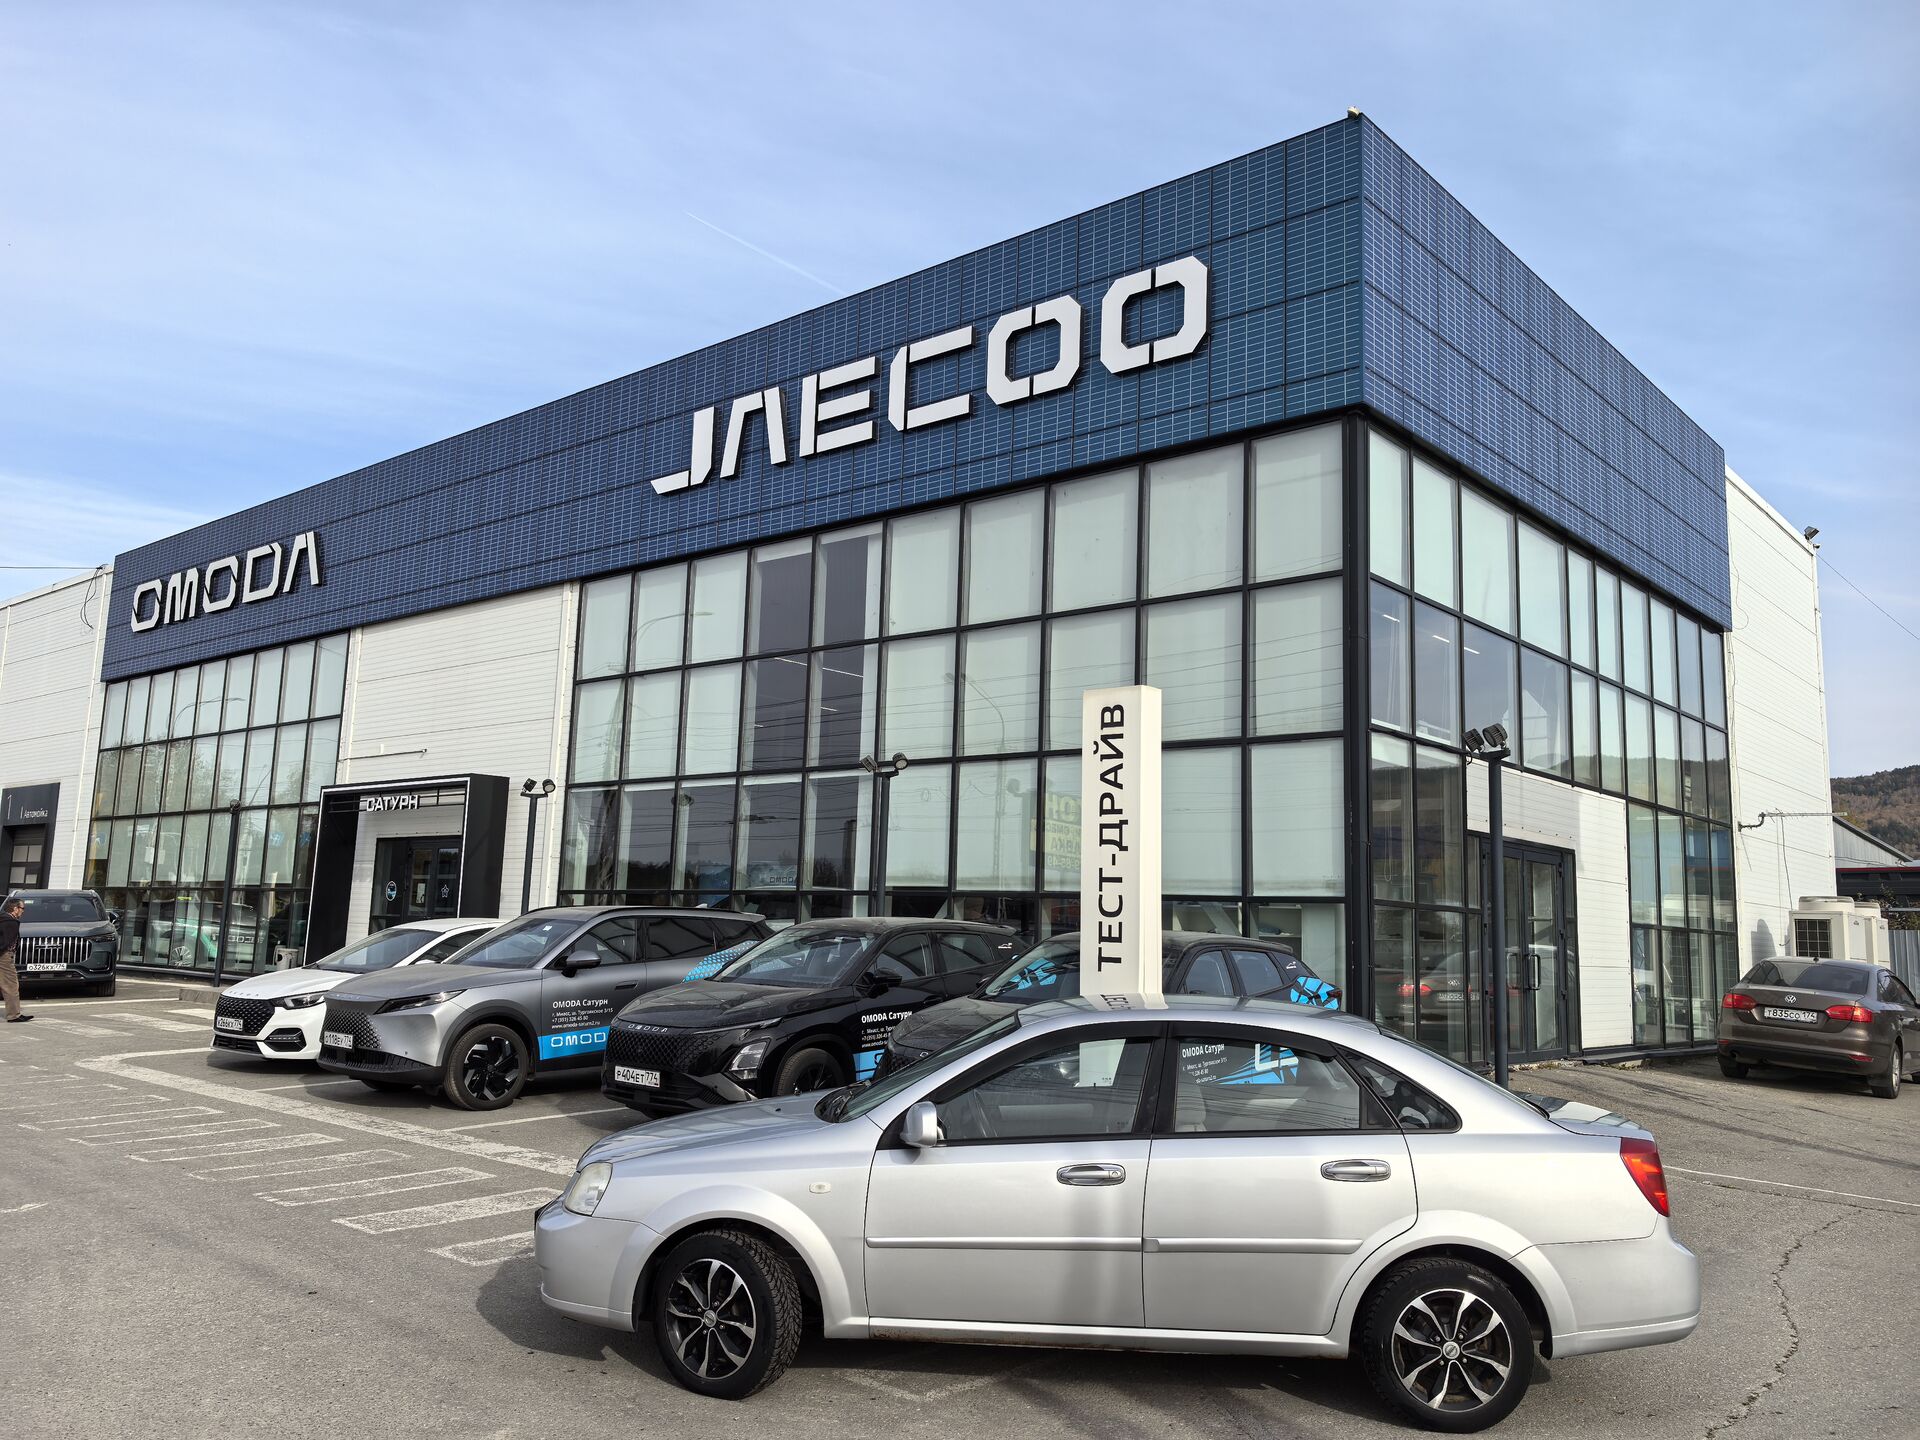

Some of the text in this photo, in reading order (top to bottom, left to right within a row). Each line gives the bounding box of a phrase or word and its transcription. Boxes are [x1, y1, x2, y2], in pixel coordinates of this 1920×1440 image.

[651, 255, 1208, 495] JAECOO
[131, 531, 319, 632] OMODA
[366, 795, 418, 812] САТУРН
[1093, 703, 1128, 972] ТЕСТ-ДРАЙВ
[552, 998, 608, 1009] OMODA Сатурн
[861, 1013, 888, 1024] OMODA
[551, 1032, 606, 1047] OMOD
[1182, 1043, 1225, 1058] OMODA Сатурн
